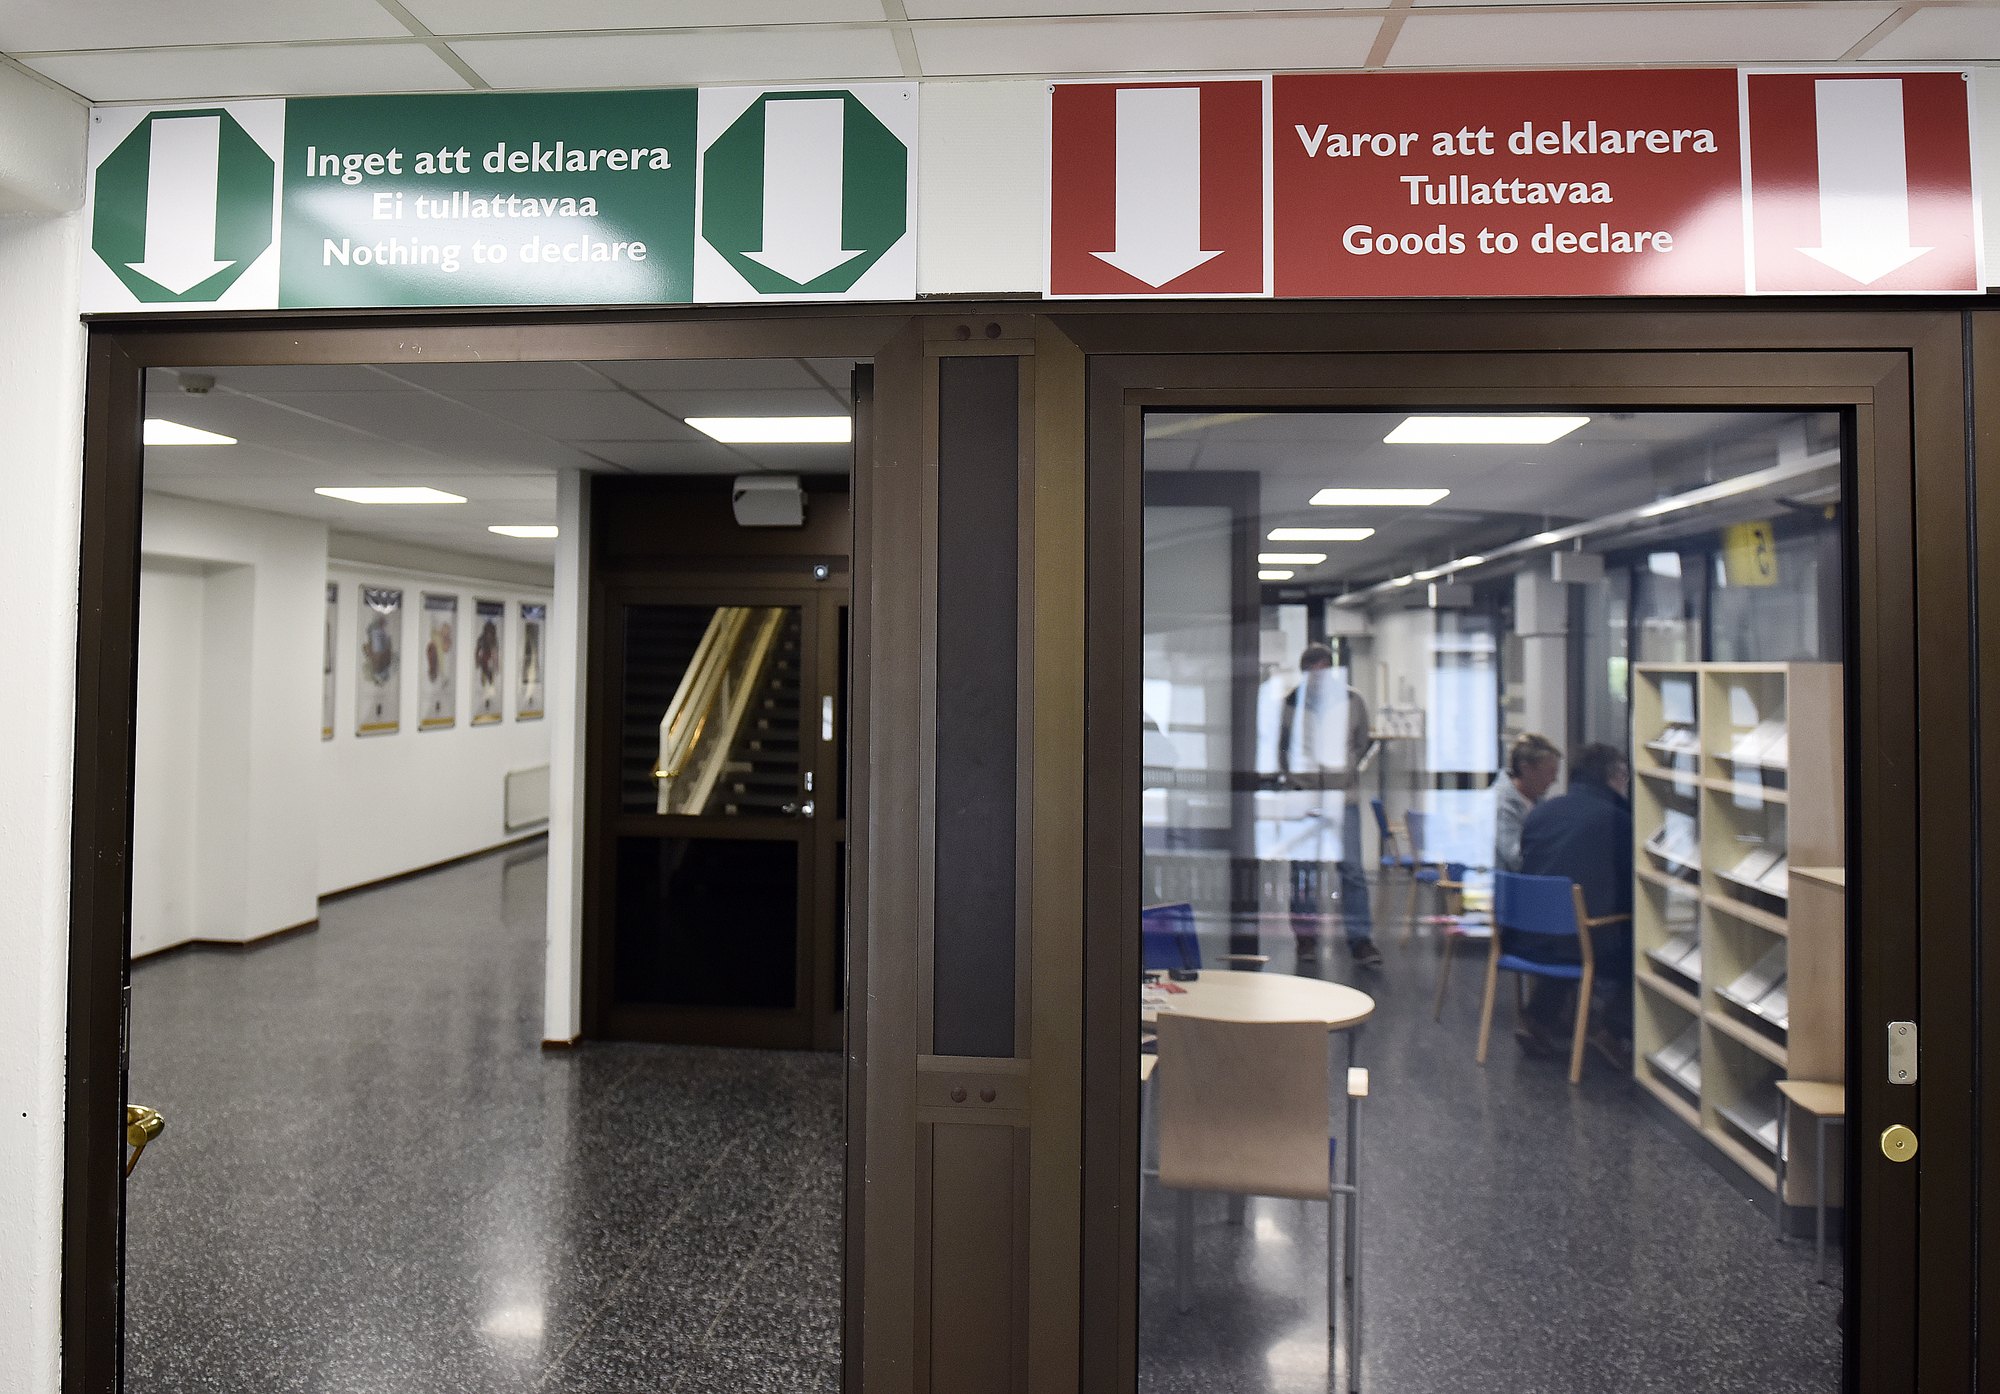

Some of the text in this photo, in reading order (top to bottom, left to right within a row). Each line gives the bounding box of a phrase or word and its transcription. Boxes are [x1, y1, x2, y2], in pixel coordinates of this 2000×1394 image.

[1294, 120, 1718, 158] Varor att deklarera
[306, 141, 672, 185] Inget att deklarera
[372, 191, 599, 220] Ei tullattavaa
[1399, 175, 1614, 205] Tullattavaa
[322, 235, 647, 273] Nothing to declare
[1342, 222, 1674, 255] Goods to declare
